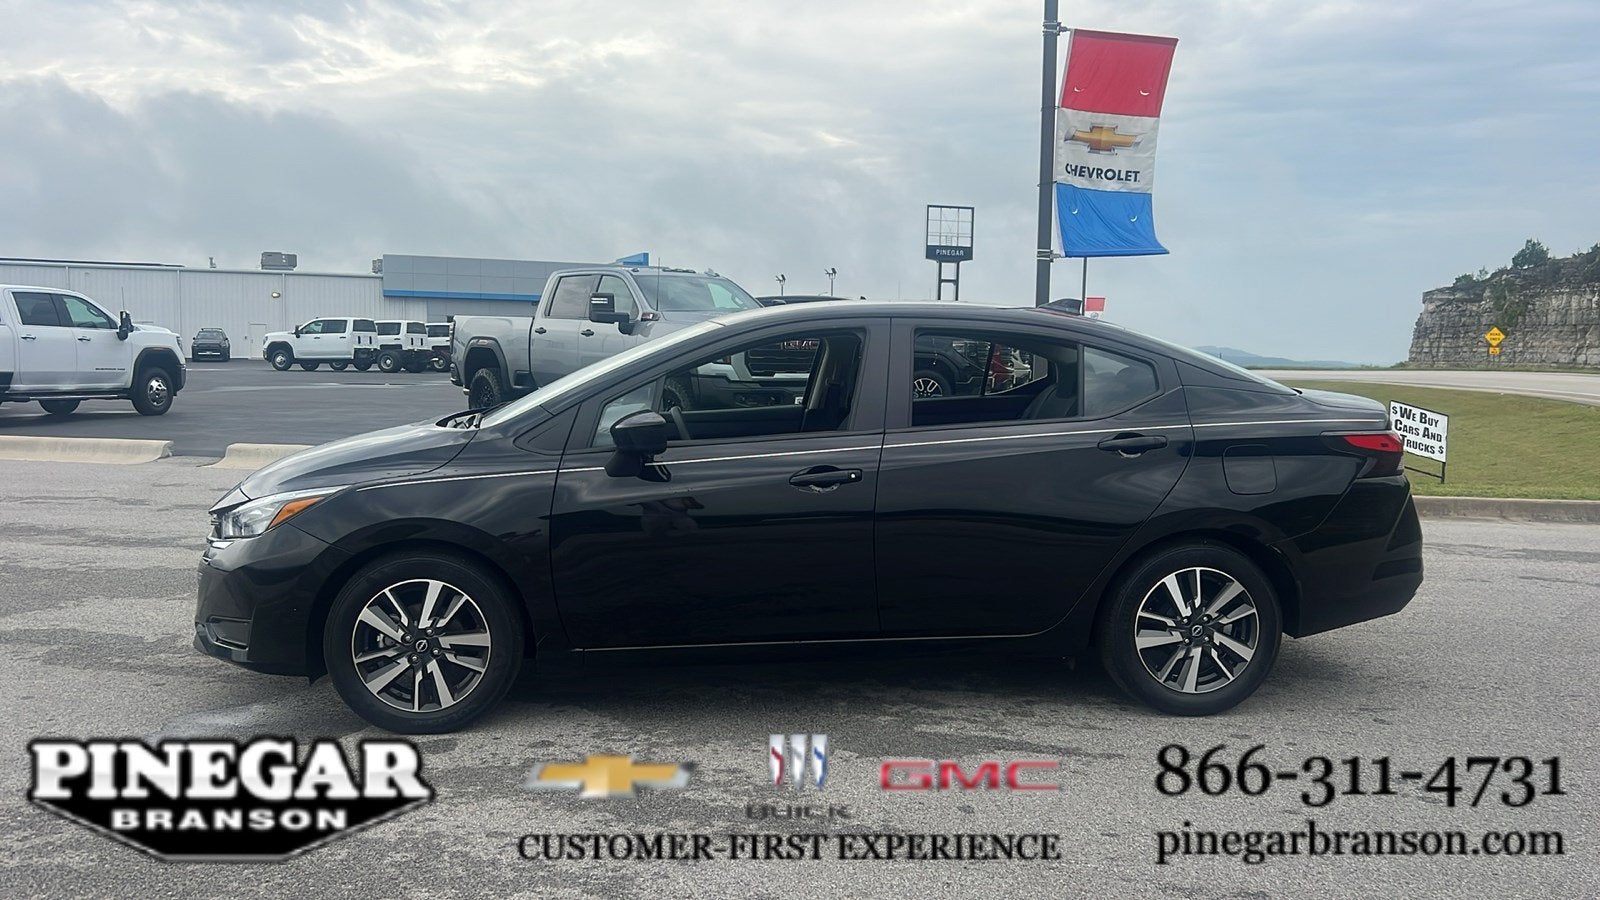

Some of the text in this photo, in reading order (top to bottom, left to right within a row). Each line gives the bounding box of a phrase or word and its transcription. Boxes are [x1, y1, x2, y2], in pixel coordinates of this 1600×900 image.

[1065, 163, 1140, 182] CHEVROLET
[1420, 412, 1439, 428] BUY
[1394, 419, 1442, 442] CARS AND
[1400, 434, 1435, 454] TRUCKS
